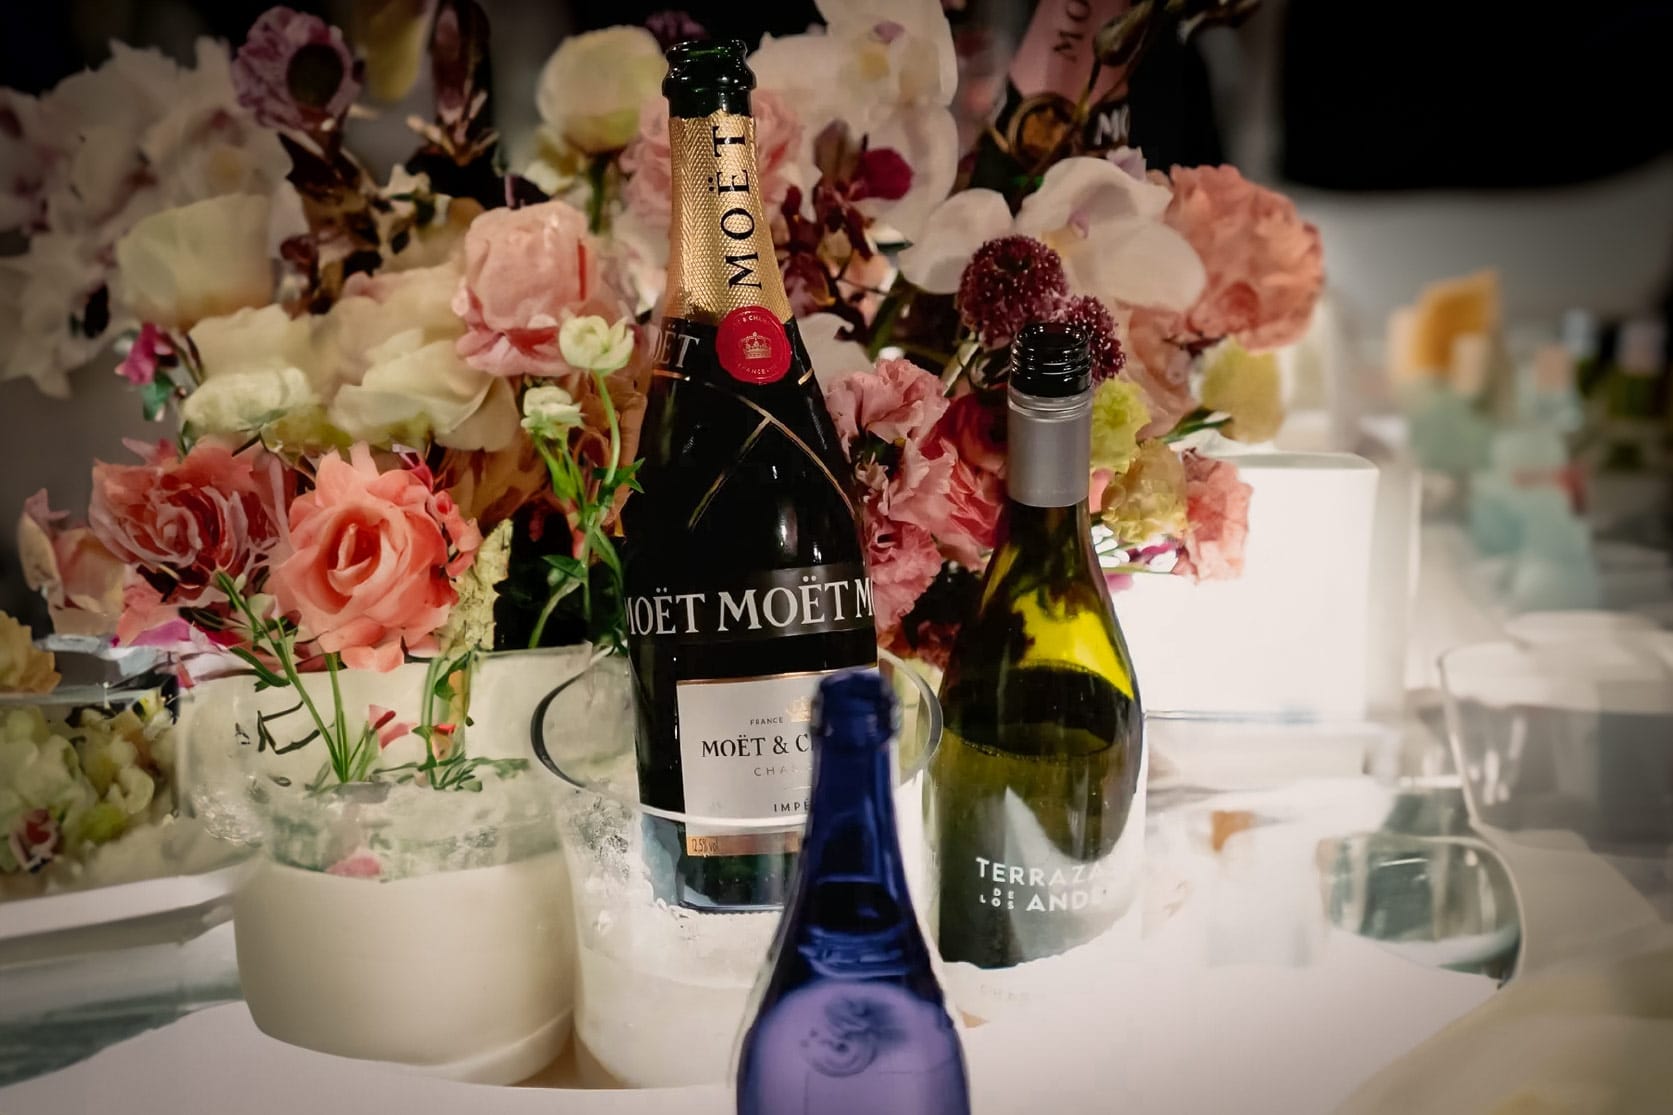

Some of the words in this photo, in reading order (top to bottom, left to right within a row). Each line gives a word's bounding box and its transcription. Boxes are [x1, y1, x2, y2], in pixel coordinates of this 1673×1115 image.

[707, 126, 763, 290] MOËT
[717, 575, 849, 632] MOËT
[854, 577, 877, 618] M
[750, 717, 784, 726] FRANCE
[701, 733, 766, 757] MOËT
[772, 735, 789, 755] &
[795, 733, 813, 752] C
[980, 894, 1015, 910] LOS
[993, 888, 1015, 900] DE
